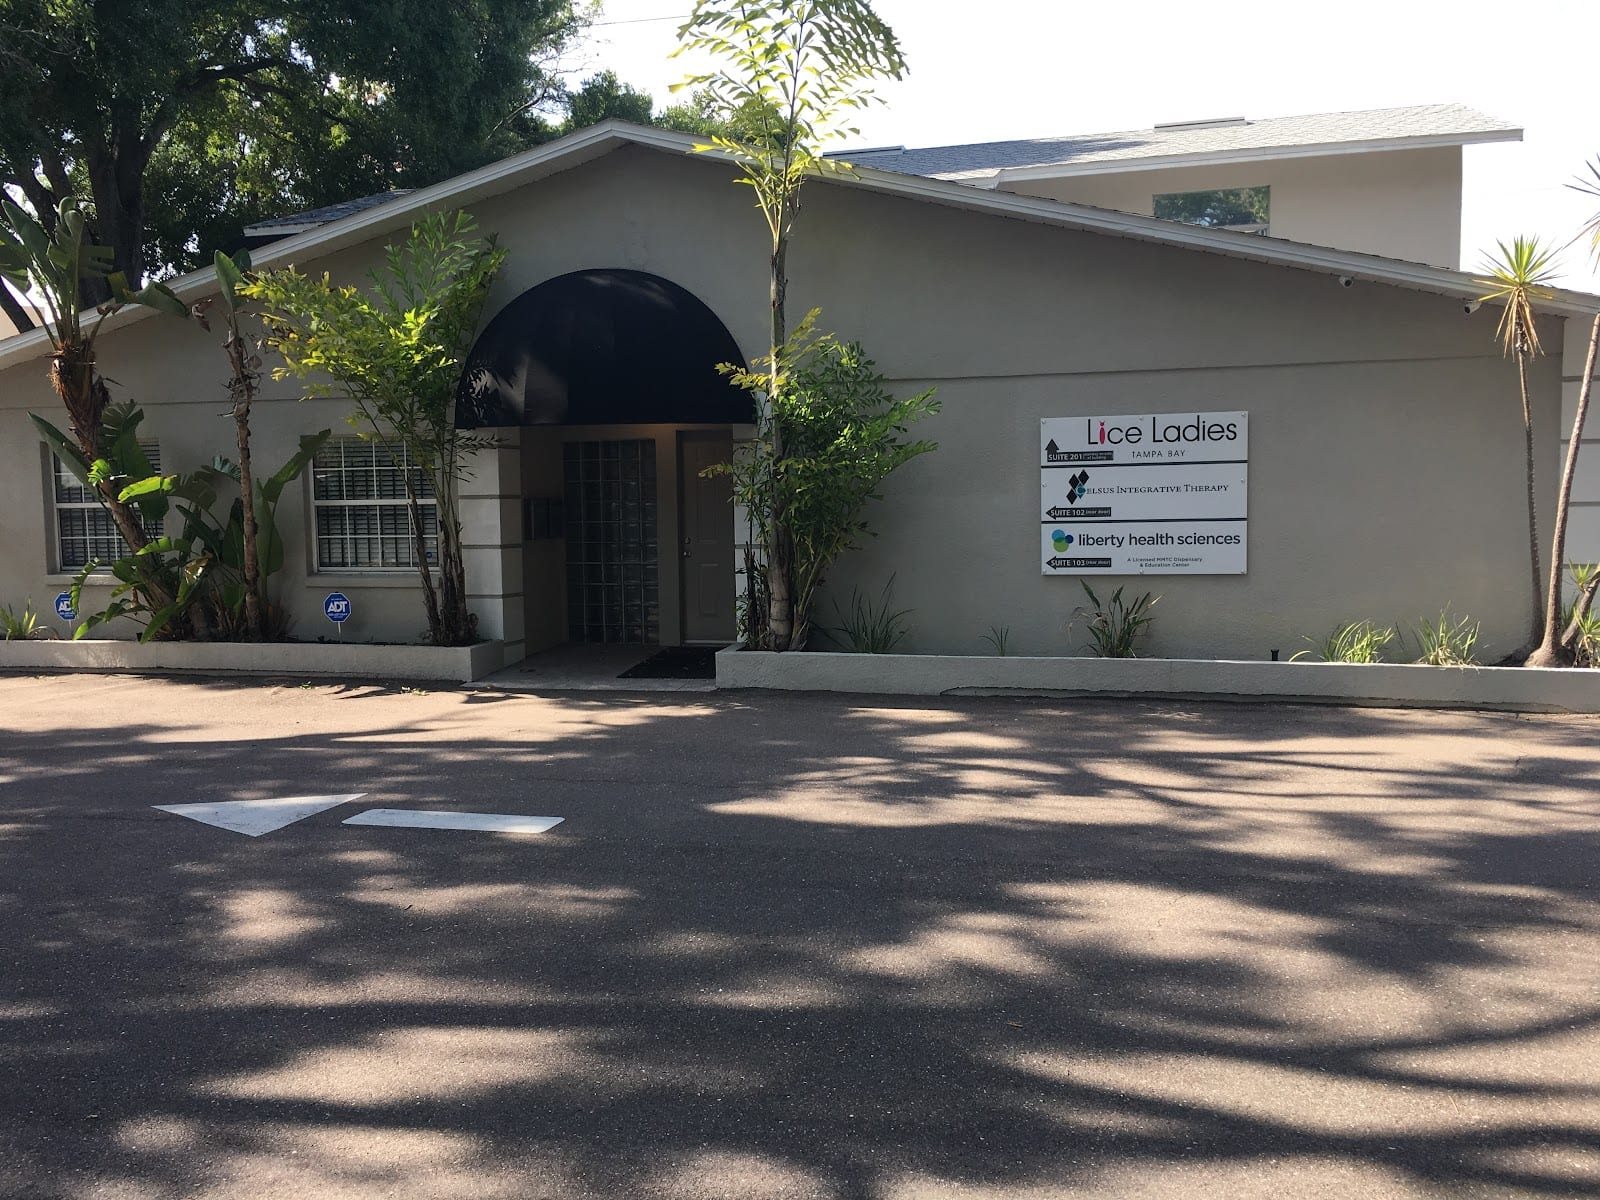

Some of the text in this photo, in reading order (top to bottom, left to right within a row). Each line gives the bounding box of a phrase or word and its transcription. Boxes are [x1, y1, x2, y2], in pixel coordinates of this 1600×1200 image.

[1087, 414, 1237, 446] Lice Ladies
[1048, 453, 1069, 461] SUITE
[1132, 449, 1186, 459] TAMPA BAY
[1116, 485, 1182, 494] INTEGRATIVE
[1183, 483, 1229, 493] THERAPY
[1050, 509, 1071, 517] SUITE
[1078, 532, 1241, 548] liberty health sciences
[1050, 559, 1071, 567] SUITE
[1072, 559, 1085, 567] 103
[58, 600, 72, 612] AD
[327, 600, 348, 613] ADT
